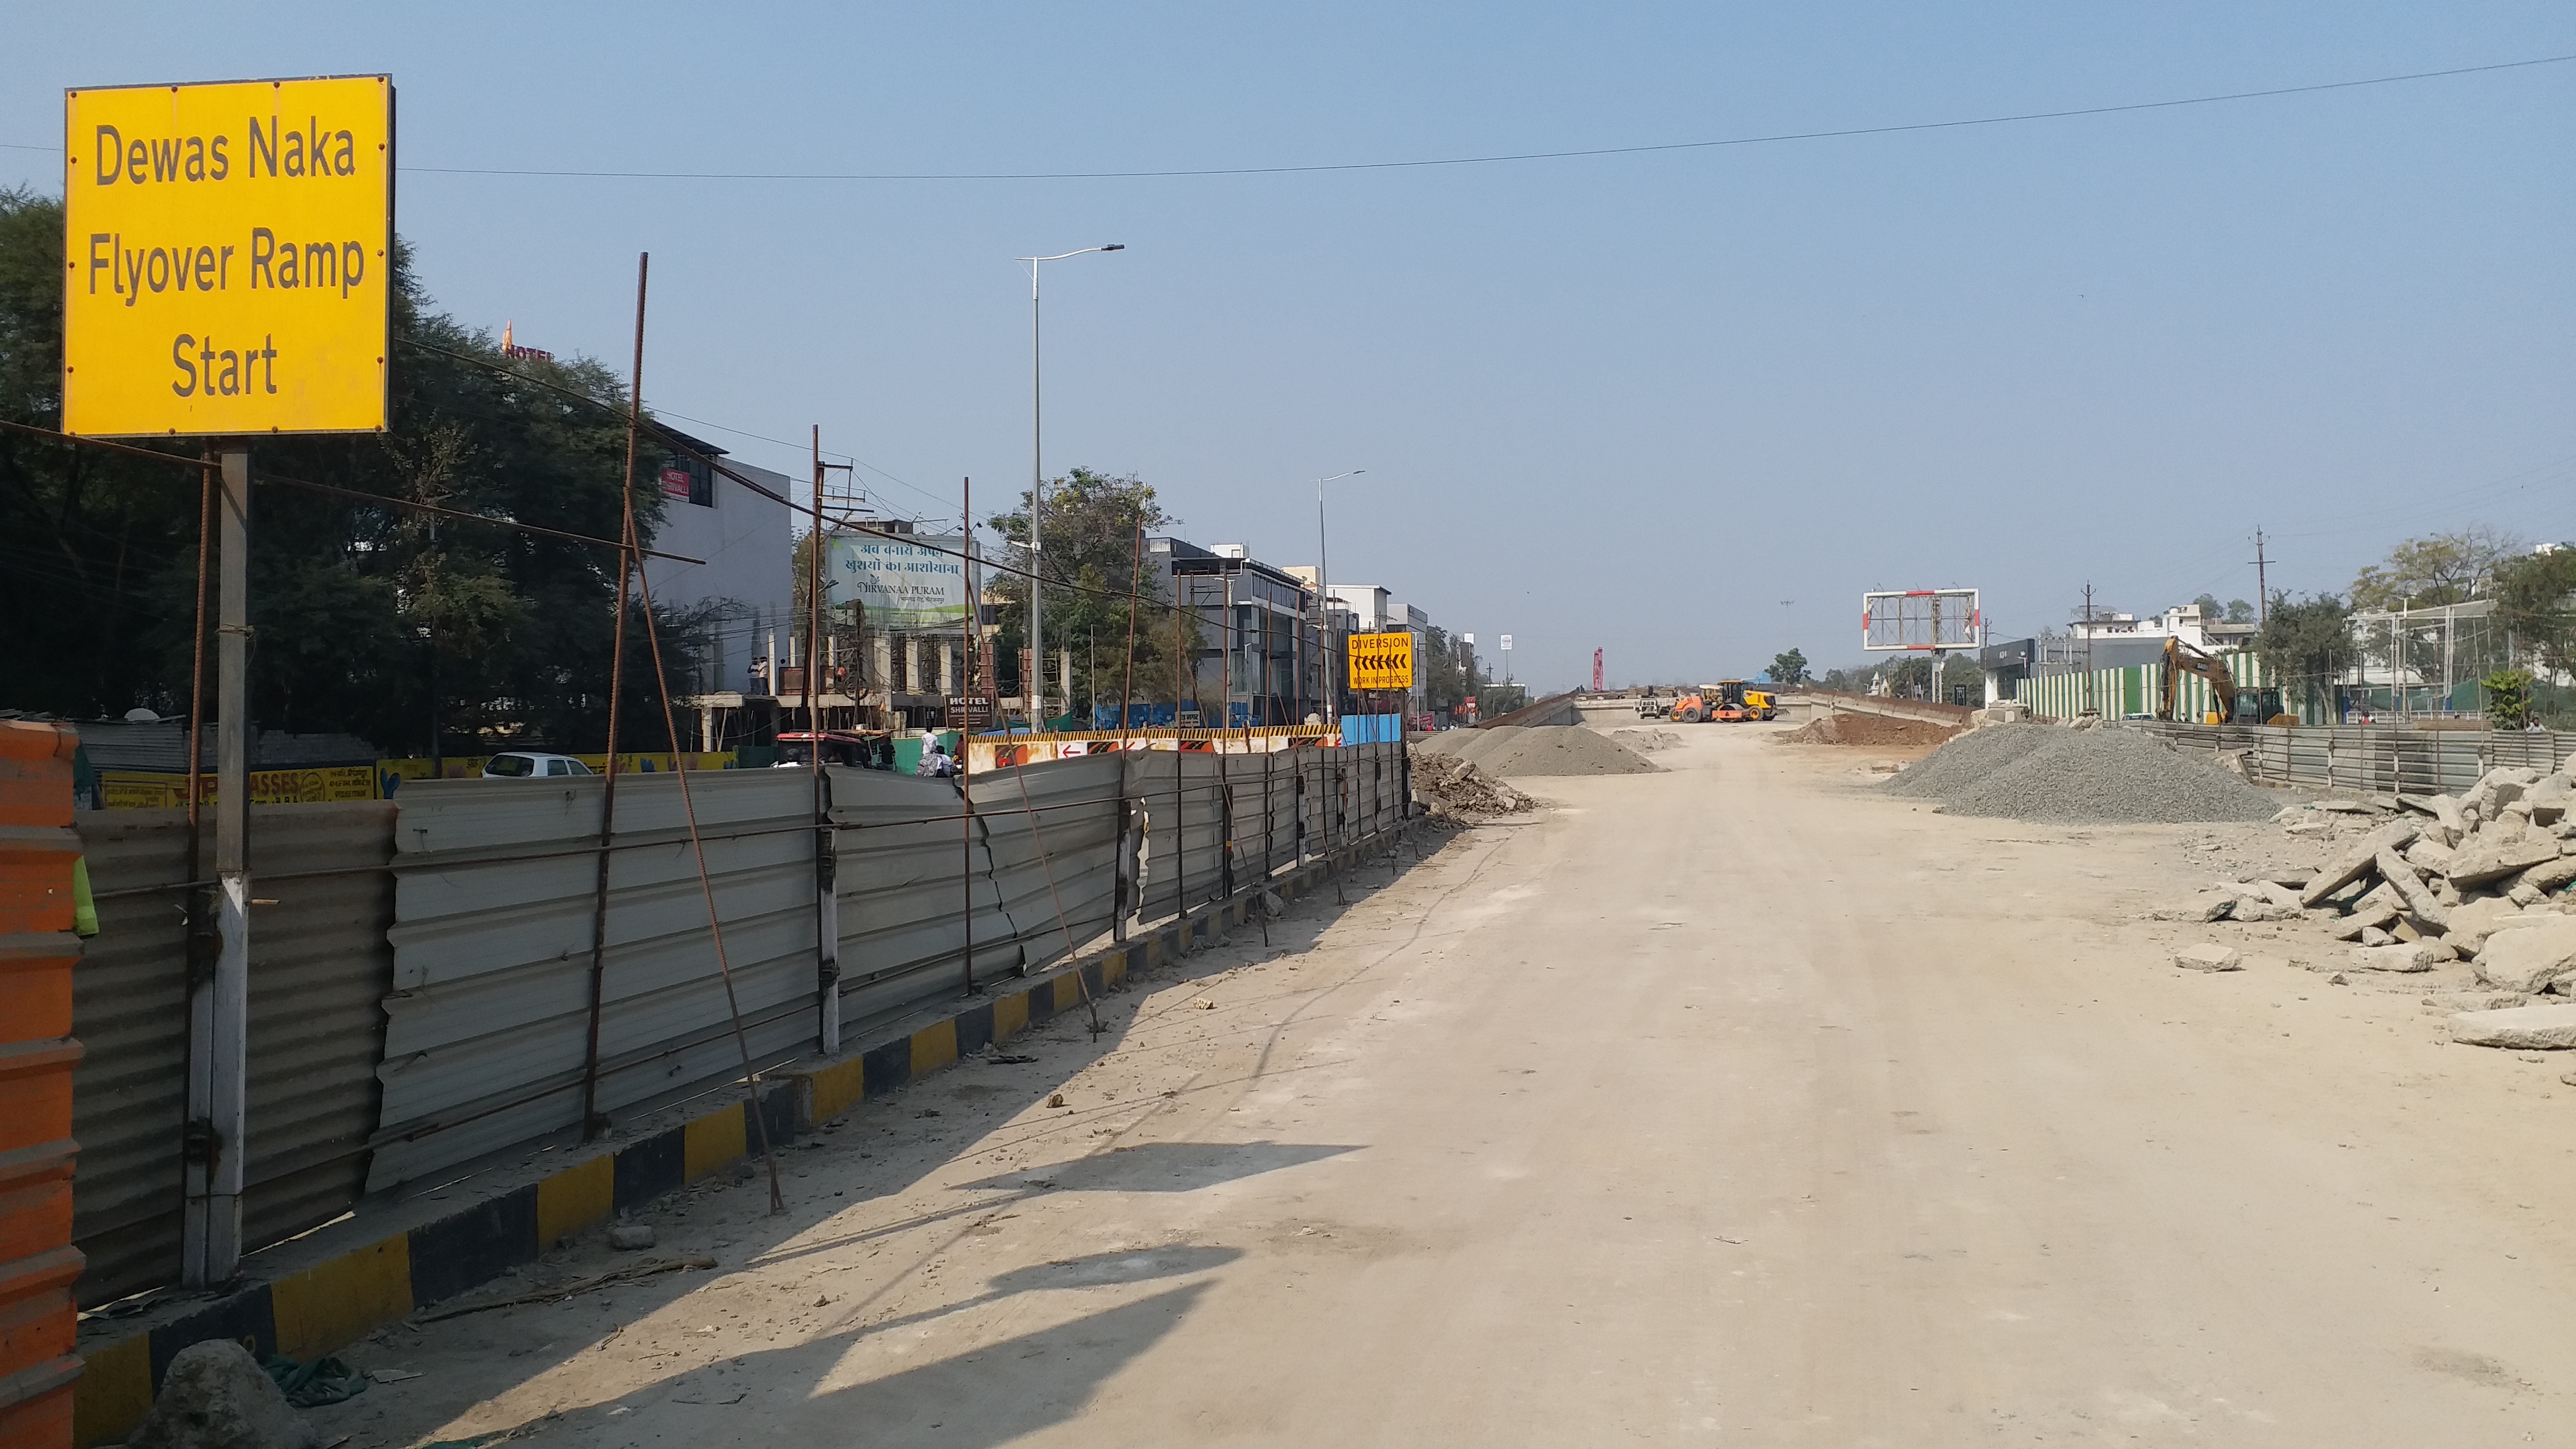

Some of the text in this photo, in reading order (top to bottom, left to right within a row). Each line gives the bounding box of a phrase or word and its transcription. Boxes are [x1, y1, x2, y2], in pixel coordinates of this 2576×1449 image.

[95, 115, 356, 186] Dewas Naka
[89, 226, 365, 307] Flyover Ramp
[171, 333, 278, 398] Start
[667, 471, 684, 483] HOTEL
[886, 562, 901, 571] का
[857, 581, 945, 595] NIRVANAA PURAM
[1352, 637, 1408, 650] DIVERSION
[1353, 674, 1409, 685] WORK IN PROGRESS
[949, 697, 989, 705] HOTEL
[250, 772, 299, 796] ASSES
